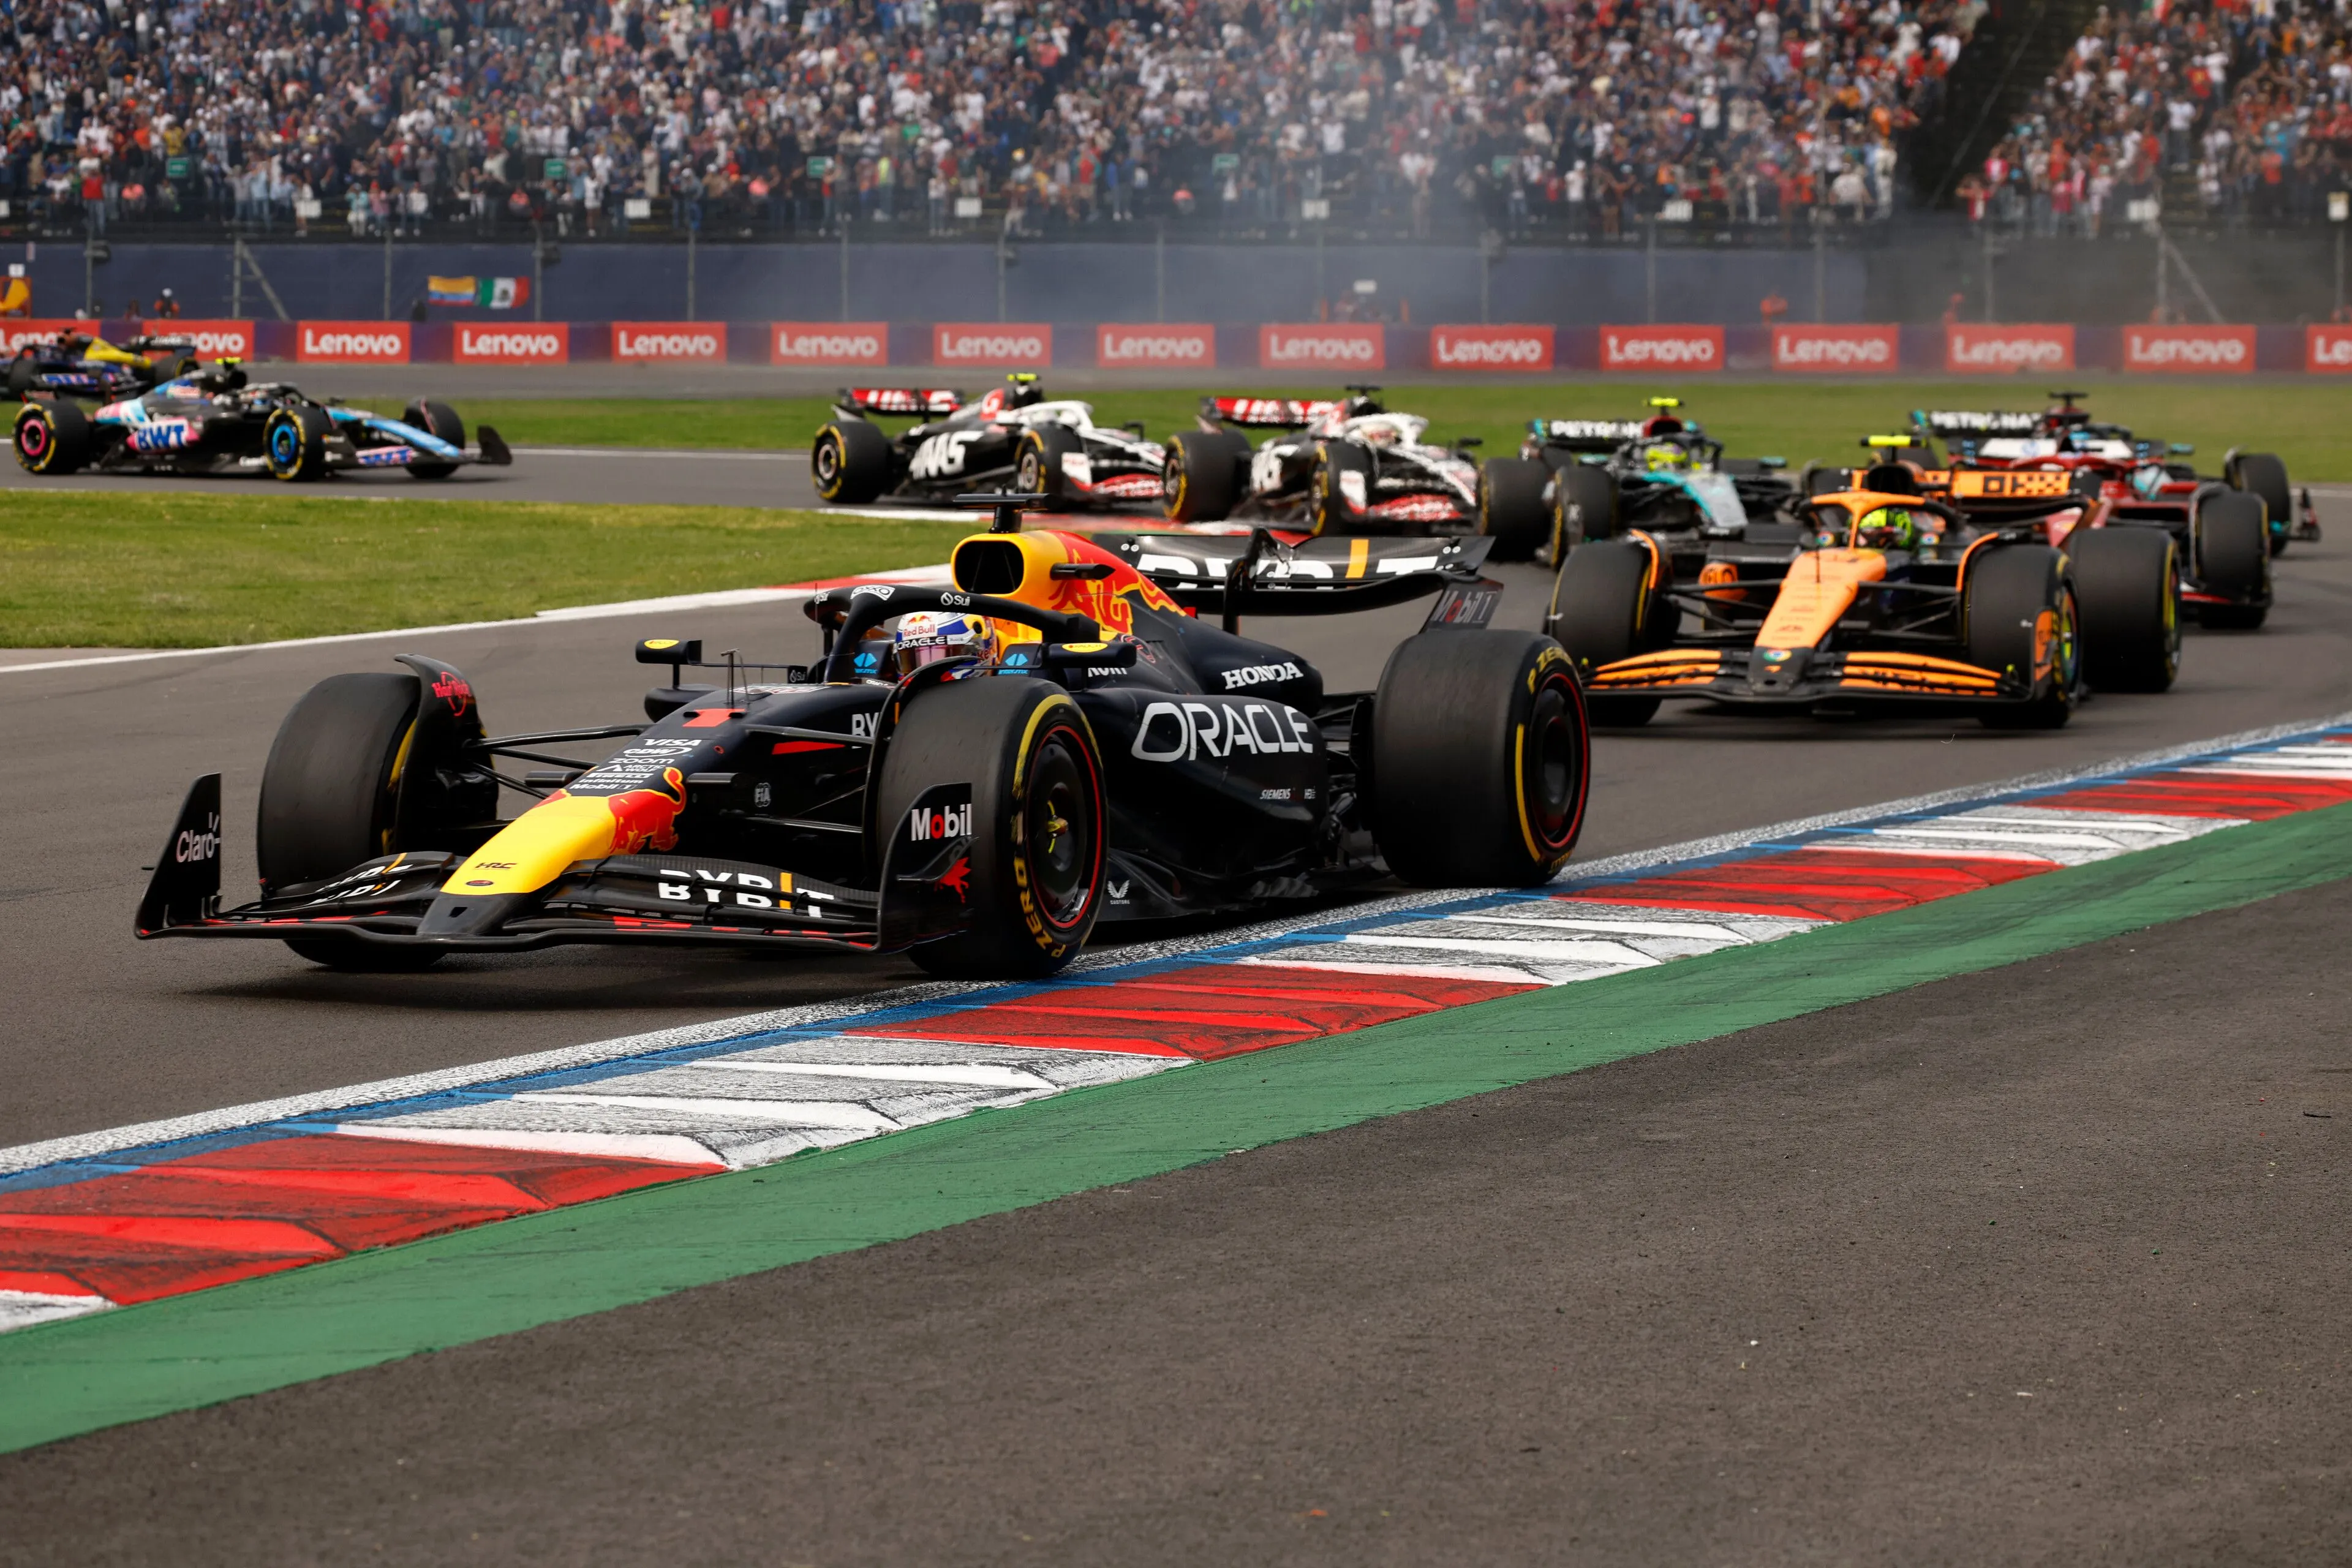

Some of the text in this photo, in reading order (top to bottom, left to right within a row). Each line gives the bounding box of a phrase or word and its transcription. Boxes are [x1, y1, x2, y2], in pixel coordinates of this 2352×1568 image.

[0, 329, 61, 352] Leno
[305, 330, 401, 356] Lenovo
[462, 331, 559, 356] Lenovo
[619, 331, 717, 357] Lenovo
[778, 332, 878, 357] Lenovo
[941, 332, 1041, 358] Lenovo
[1104, 333, 1204, 359] Lenovo
[1269, 334, 1374, 360] Lenovo
[1437, 336, 1542, 362] Lenovo
[1607, 335, 1714, 362] Lenovo
[1778, 335, 1890, 363] Lenovo
[1953, 336, 2064, 363] Lenovo
[2130, 335, 2245, 363] Lenovo
[137, 423, 186, 451] BWT
[954, 595, 971, 606] Sui
[1430, 590, 1484, 624] Mobil
[896, 636, 946, 650] ORACLE
[903, 624, 935, 636] Red Bull
[1221, 662, 1303, 689] HONDA
[1131, 701, 1313, 762] ORACLE
[1259, 788, 1291, 800] SIEMENS
[911, 803, 972, 842] Mobil
[176, 831, 215, 863] Claro
[1013, 857, 1053, 951] ZERO
